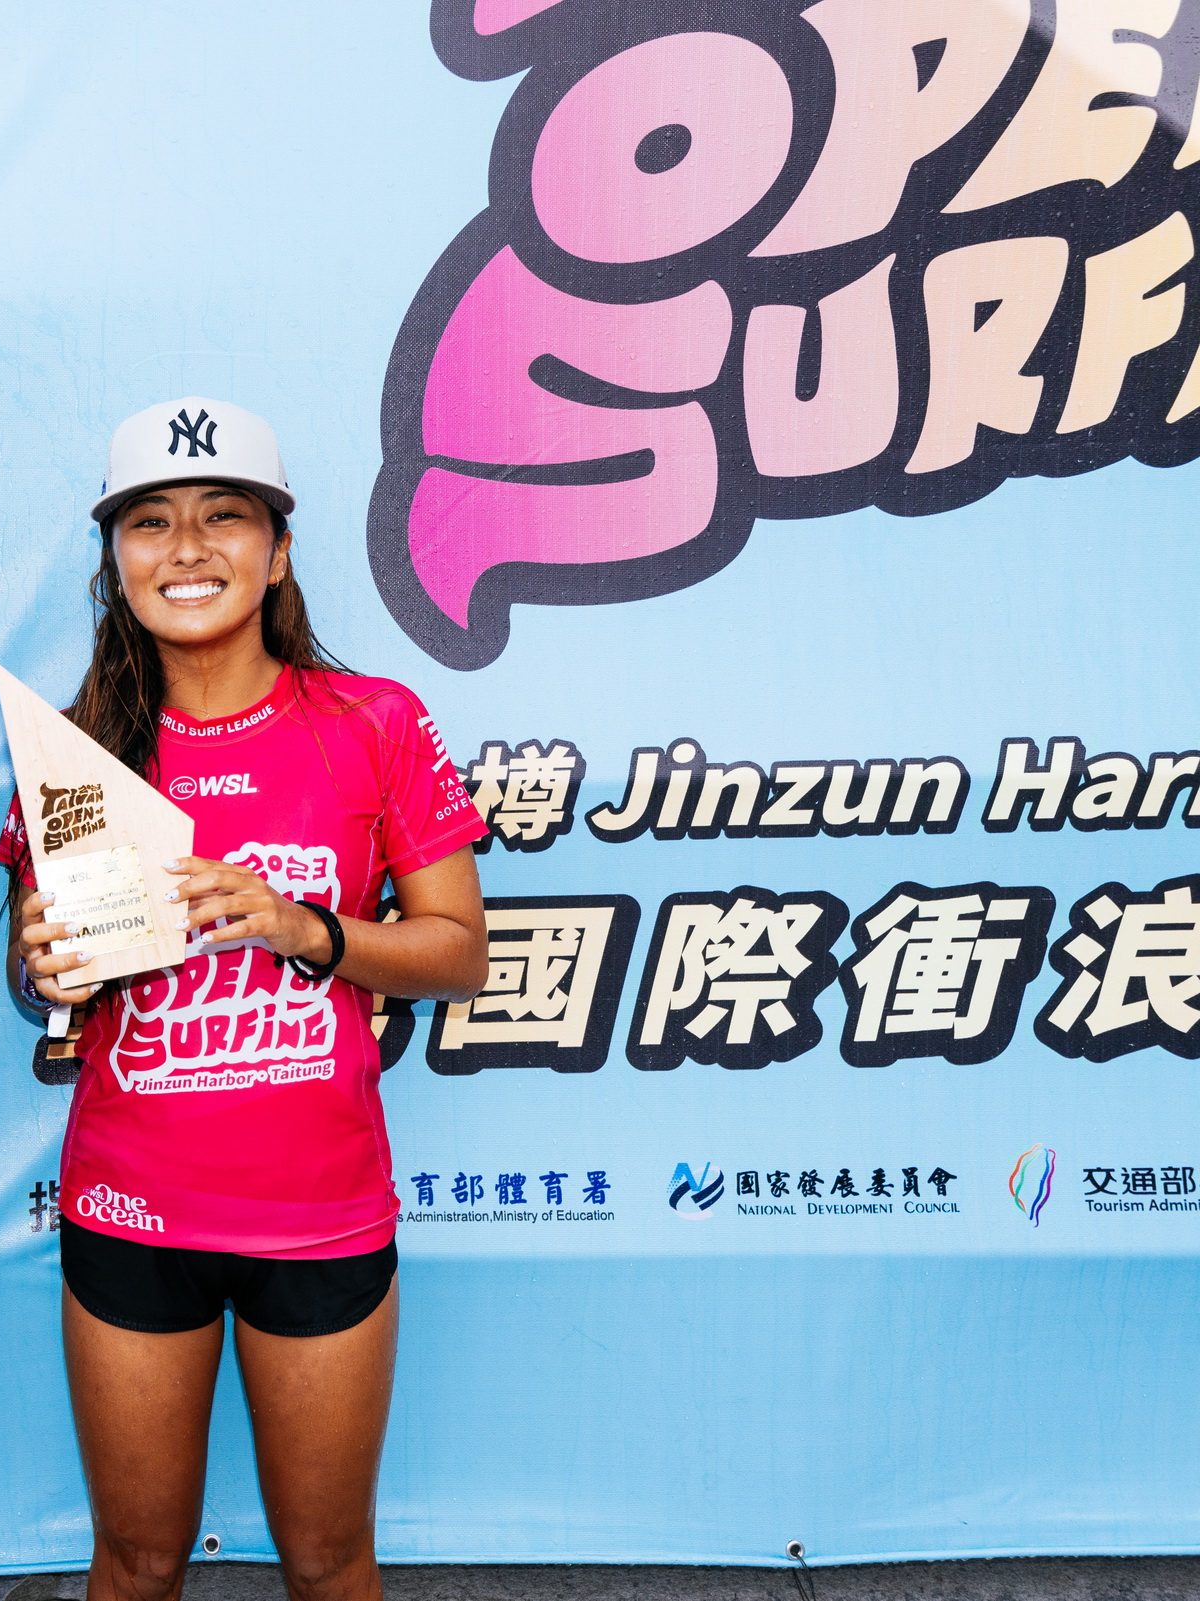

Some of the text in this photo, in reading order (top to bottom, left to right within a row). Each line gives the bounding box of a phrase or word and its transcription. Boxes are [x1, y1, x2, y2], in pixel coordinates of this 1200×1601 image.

[531, 0, 1200, 264] OPE
[408, 211, 1200, 630] SURF
[188, 724, 224, 737] SURF
[226, 703, 276, 733] LEAGUE
[39, 781, 104, 820] TAIWAN
[198, 773, 258, 797] WSL
[456, 742, 1200, 842] 樽 Jinzun Har
[43, 816, 107, 856] SURFING
[46, 806, 95, 834] OPEN
[68, 871, 92, 883] WSL
[373, 888, 1200, 1052] 國際衝浪
[116, 1003, 333, 1089] SURFING
[138, 1060, 333, 1092] Jinzun Harbor Taitung
[89, 1188, 105, 1201] WSL
[736, 1166, 958, 1198] 國家發展委員會
[76, 1194, 166, 1233] Ocean
[94, 1183, 148, 1214] One
[737, 1201, 961, 1216] NATIONAL DEVELOPMENT COUNCIL
[1085, 1199, 1144, 1212] Tourism
[541, 1210, 554, 1222] of
[557, 1209, 615, 1222] Education
